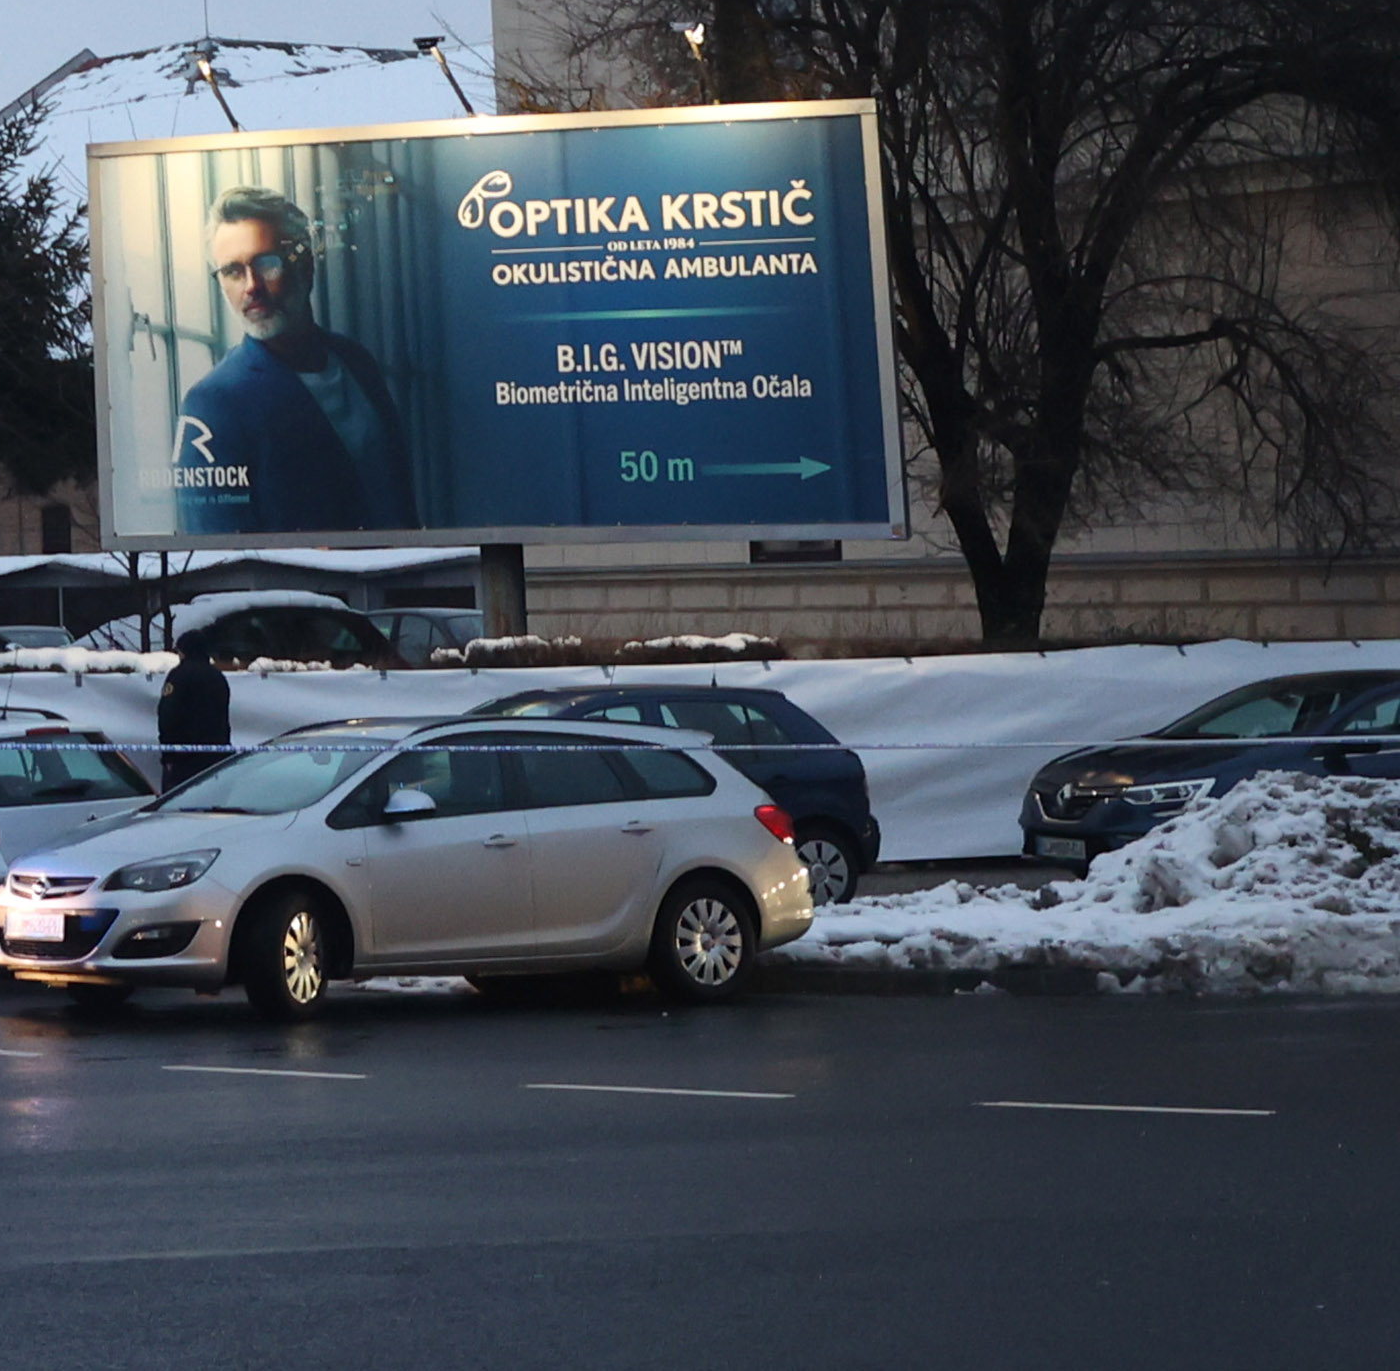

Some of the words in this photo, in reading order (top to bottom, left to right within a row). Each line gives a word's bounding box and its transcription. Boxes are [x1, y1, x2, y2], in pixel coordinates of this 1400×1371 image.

[488, 195, 650, 238] OPTIKA
[661, 179, 816, 231] KRSTIČ
[607, 241, 628, 251] OD
[630, 240, 661, 250] LETA
[663, 237, 695, 250] 1984
[492, 256, 656, 285] OKULISTIČNA
[664, 252, 818, 280] AMBULANTA
[557, 343, 626, 373] B.I.G.
[496, 379, 618, 405] Biometrična
[624, 377, 747, 405] Inteligentna
[752, 374, 812, 399] Očala
[620, 450, 658, 482] 50
[667, 456, 694, 482] m
